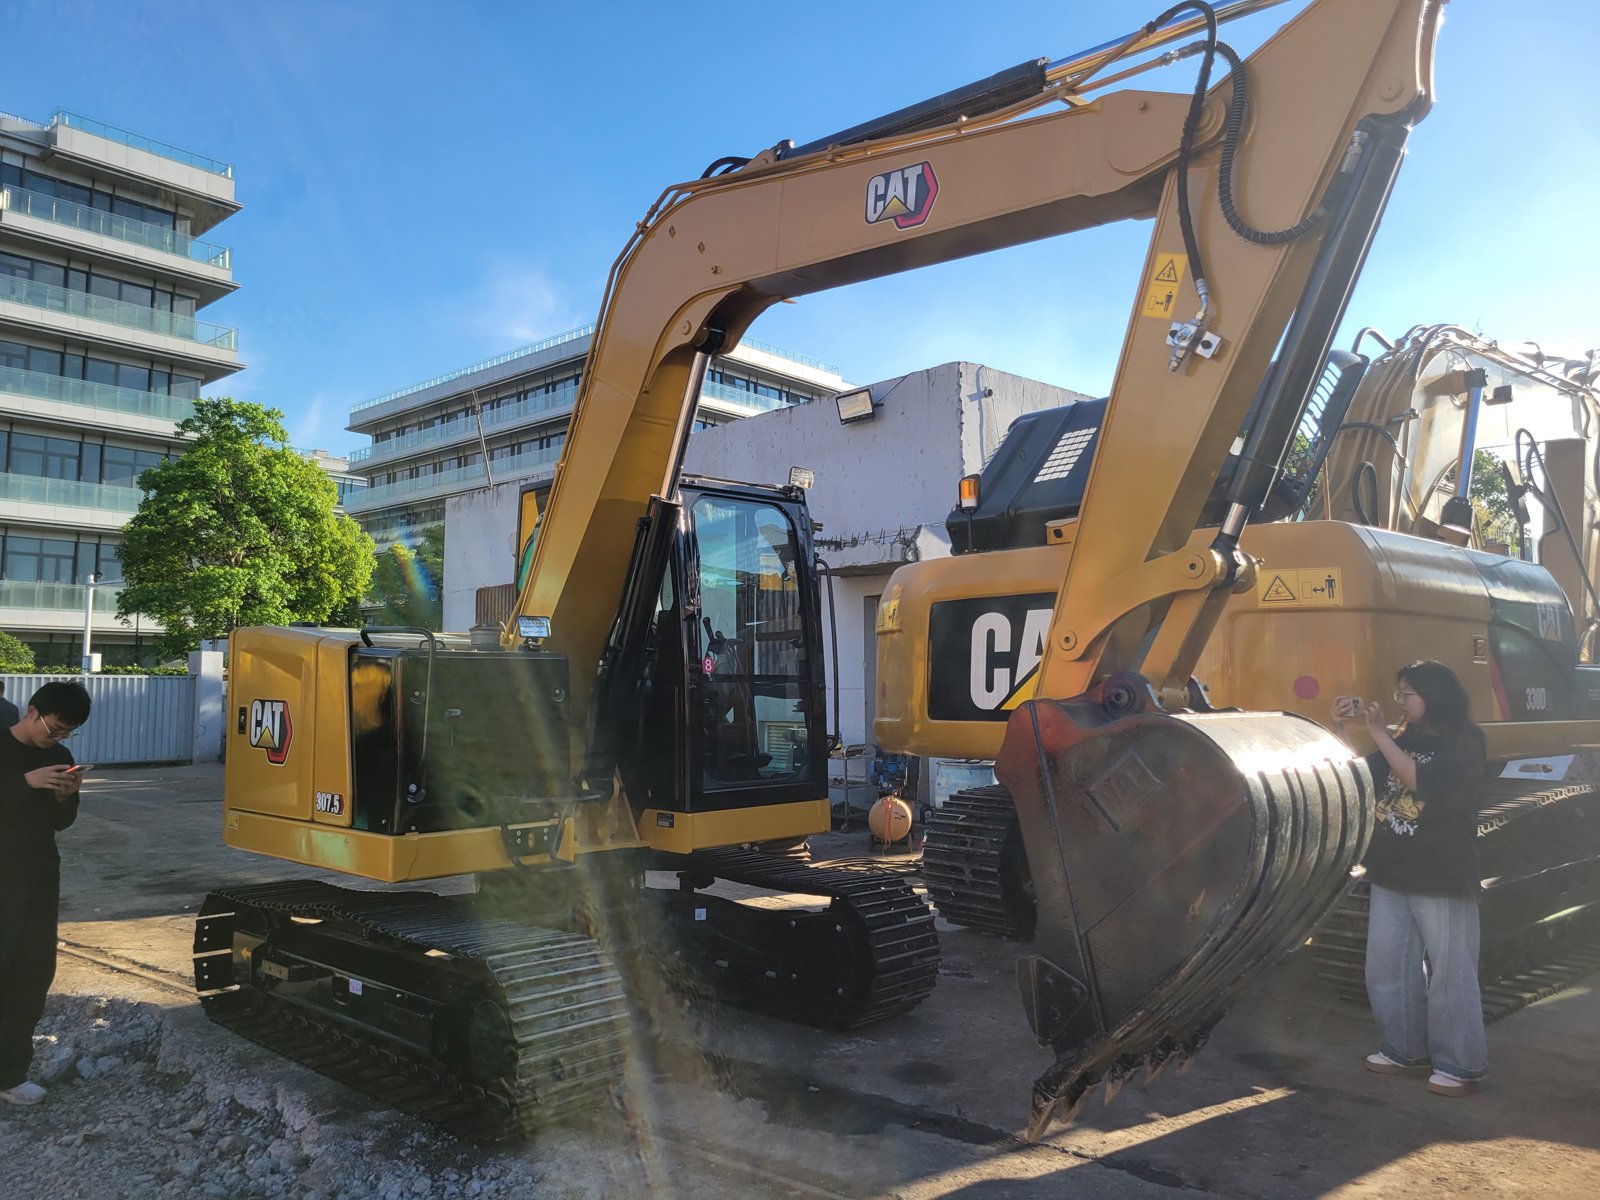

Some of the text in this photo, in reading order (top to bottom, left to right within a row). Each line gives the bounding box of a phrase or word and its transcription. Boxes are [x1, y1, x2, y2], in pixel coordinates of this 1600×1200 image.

[866, 164, 923, 222] CAT
[1536, 602, 1561, 641] CAT
[970, 608, 1054, 710] CA
[250, 699, 284, 748] CAT
[315, 791, 340, 814] 307.5
